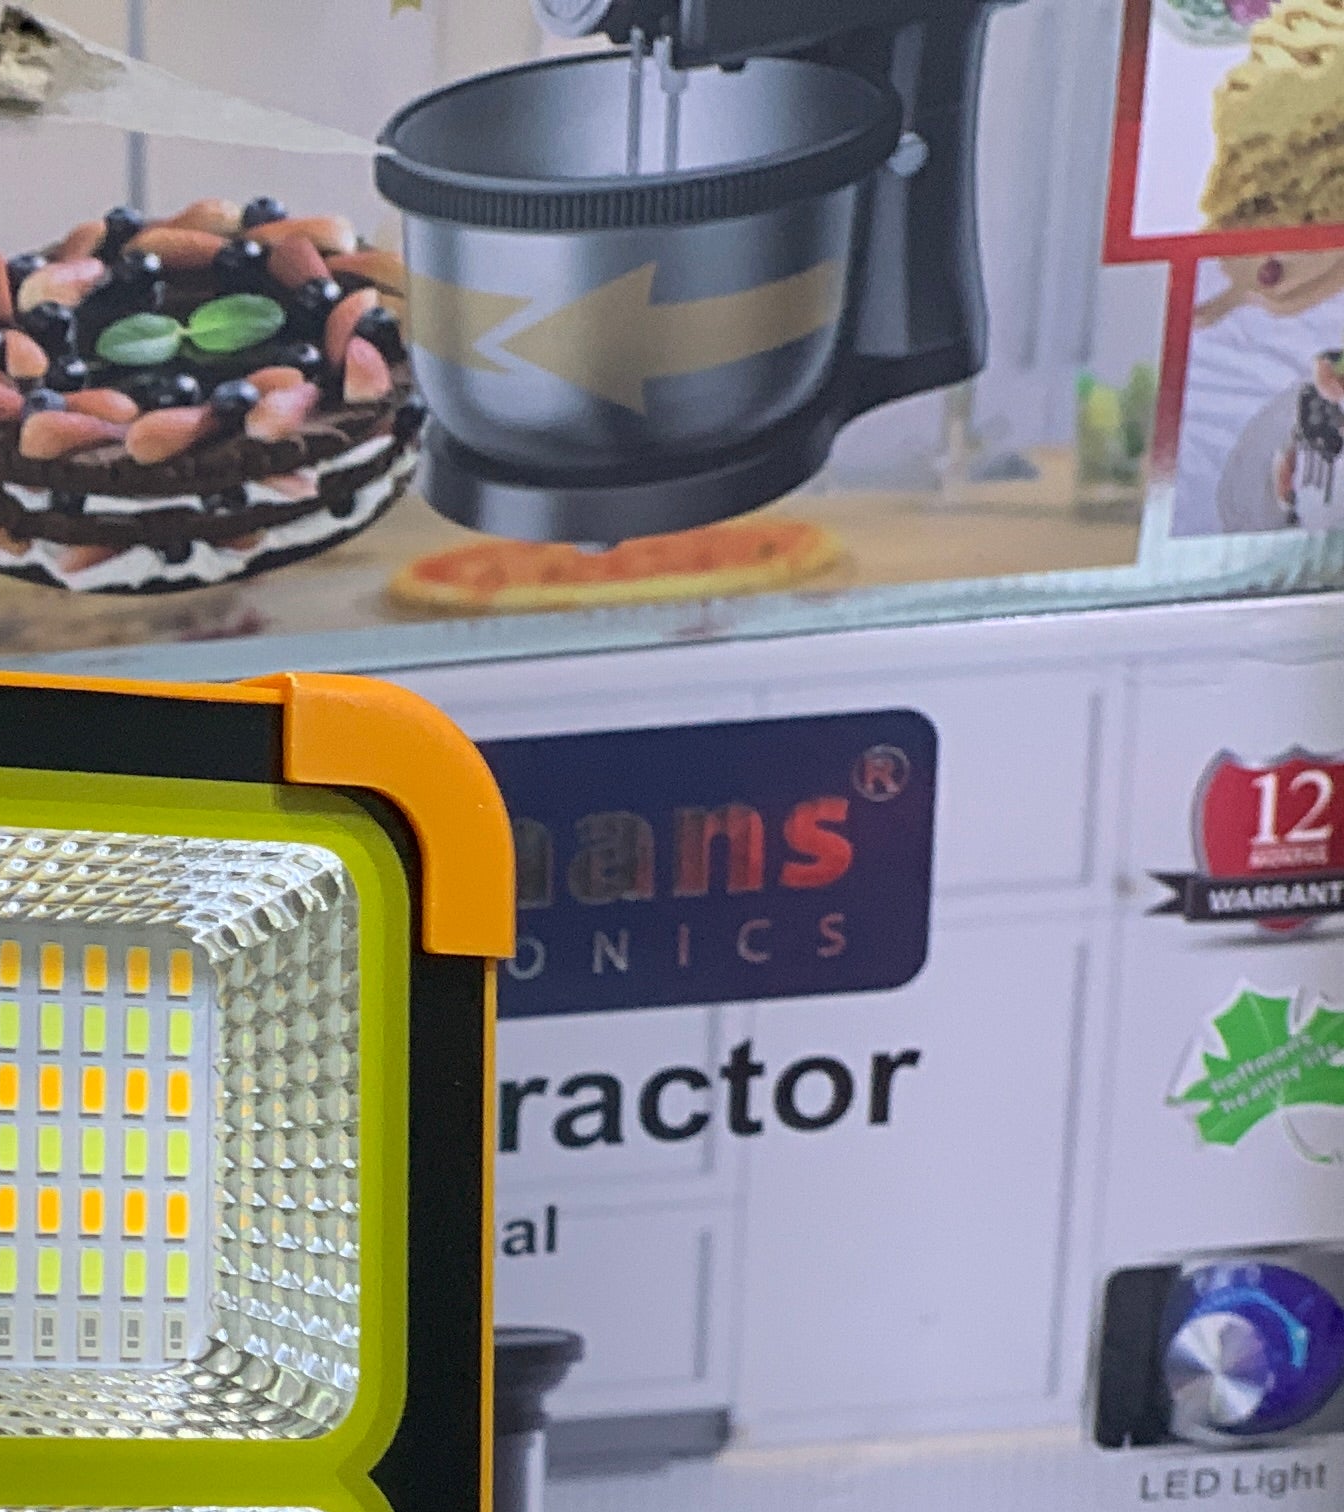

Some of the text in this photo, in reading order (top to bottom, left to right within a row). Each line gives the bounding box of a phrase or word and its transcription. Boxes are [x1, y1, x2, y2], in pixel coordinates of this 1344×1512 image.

[1250, 769, 1334, 846] 12
[1208, 879, 1344, 912] WARRANT
[505, 912, 848, 981] ONICS
[499, 1037, 922, 1153] ractor
[500, 1205, 558, 1257] al
[1139, 1457, 1329, 1502] LED Light
